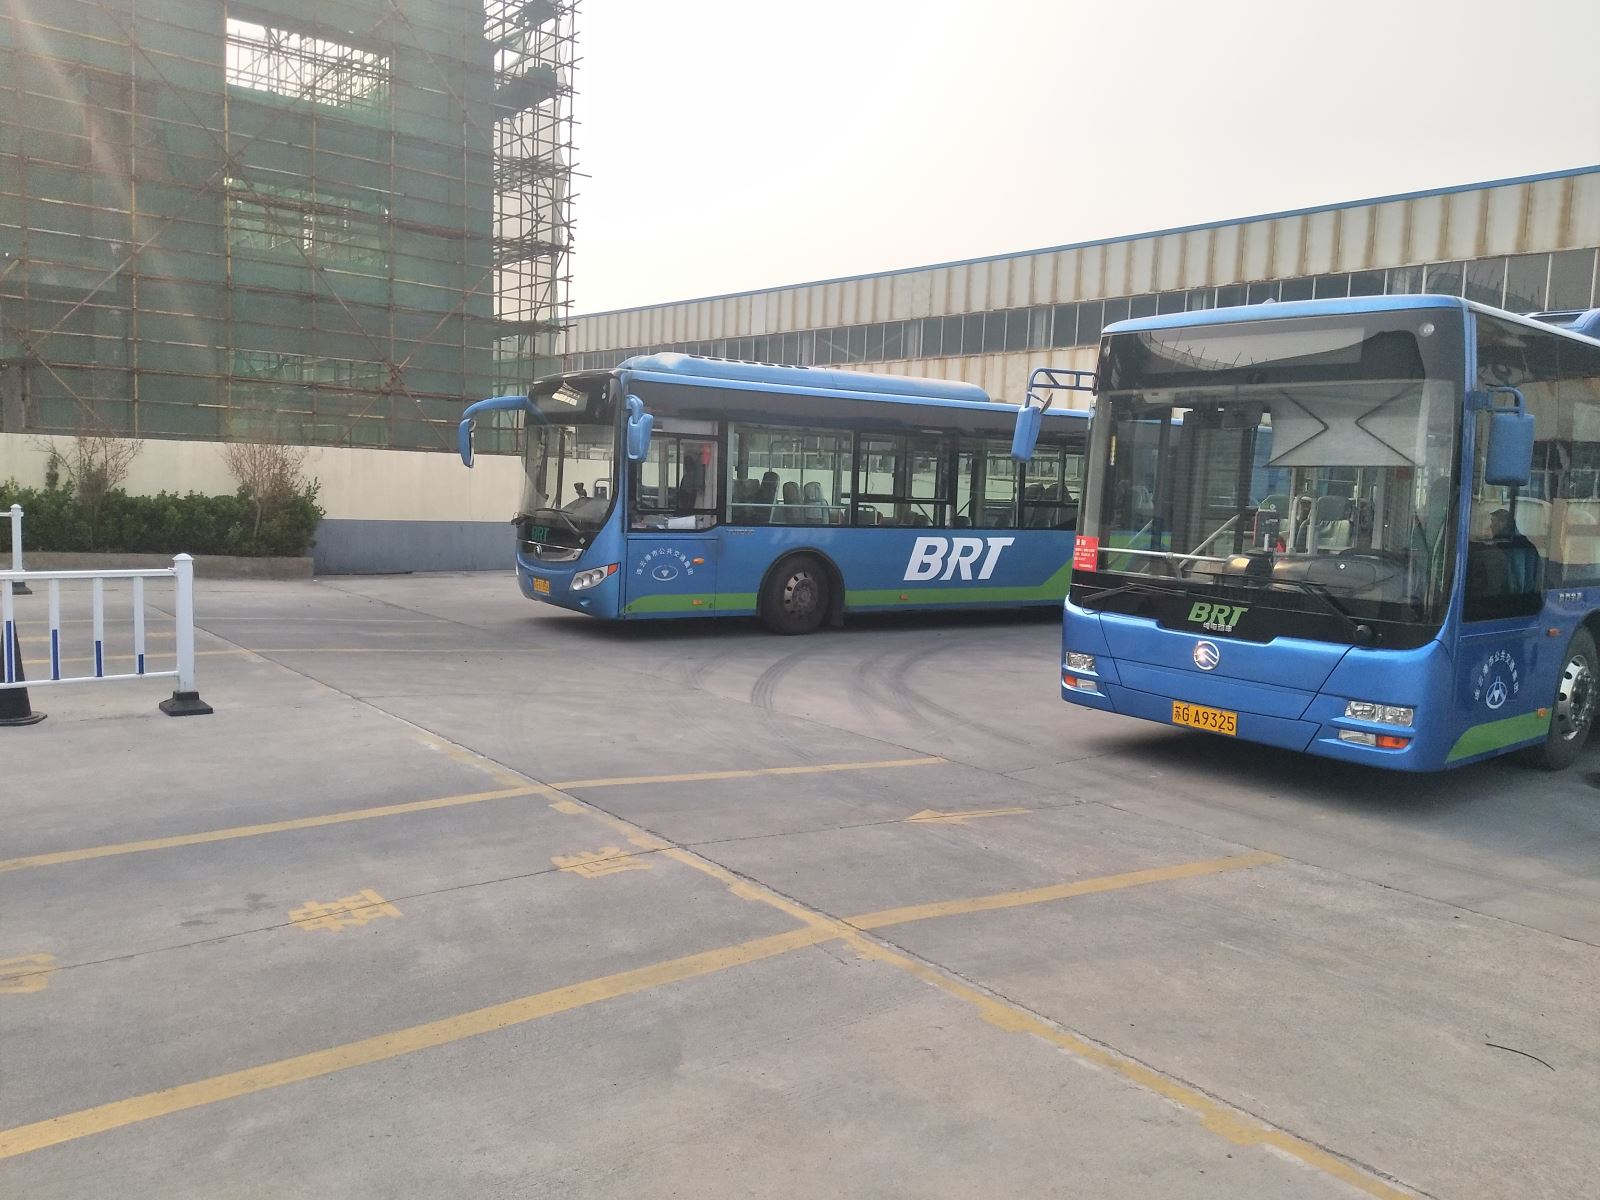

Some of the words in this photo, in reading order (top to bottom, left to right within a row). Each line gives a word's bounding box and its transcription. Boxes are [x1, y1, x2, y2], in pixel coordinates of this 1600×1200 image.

[531, 525, 550, 541] BRT
[903, 536, 1016, 581] BRT
[1187, 601, 1249, 627] BRT
